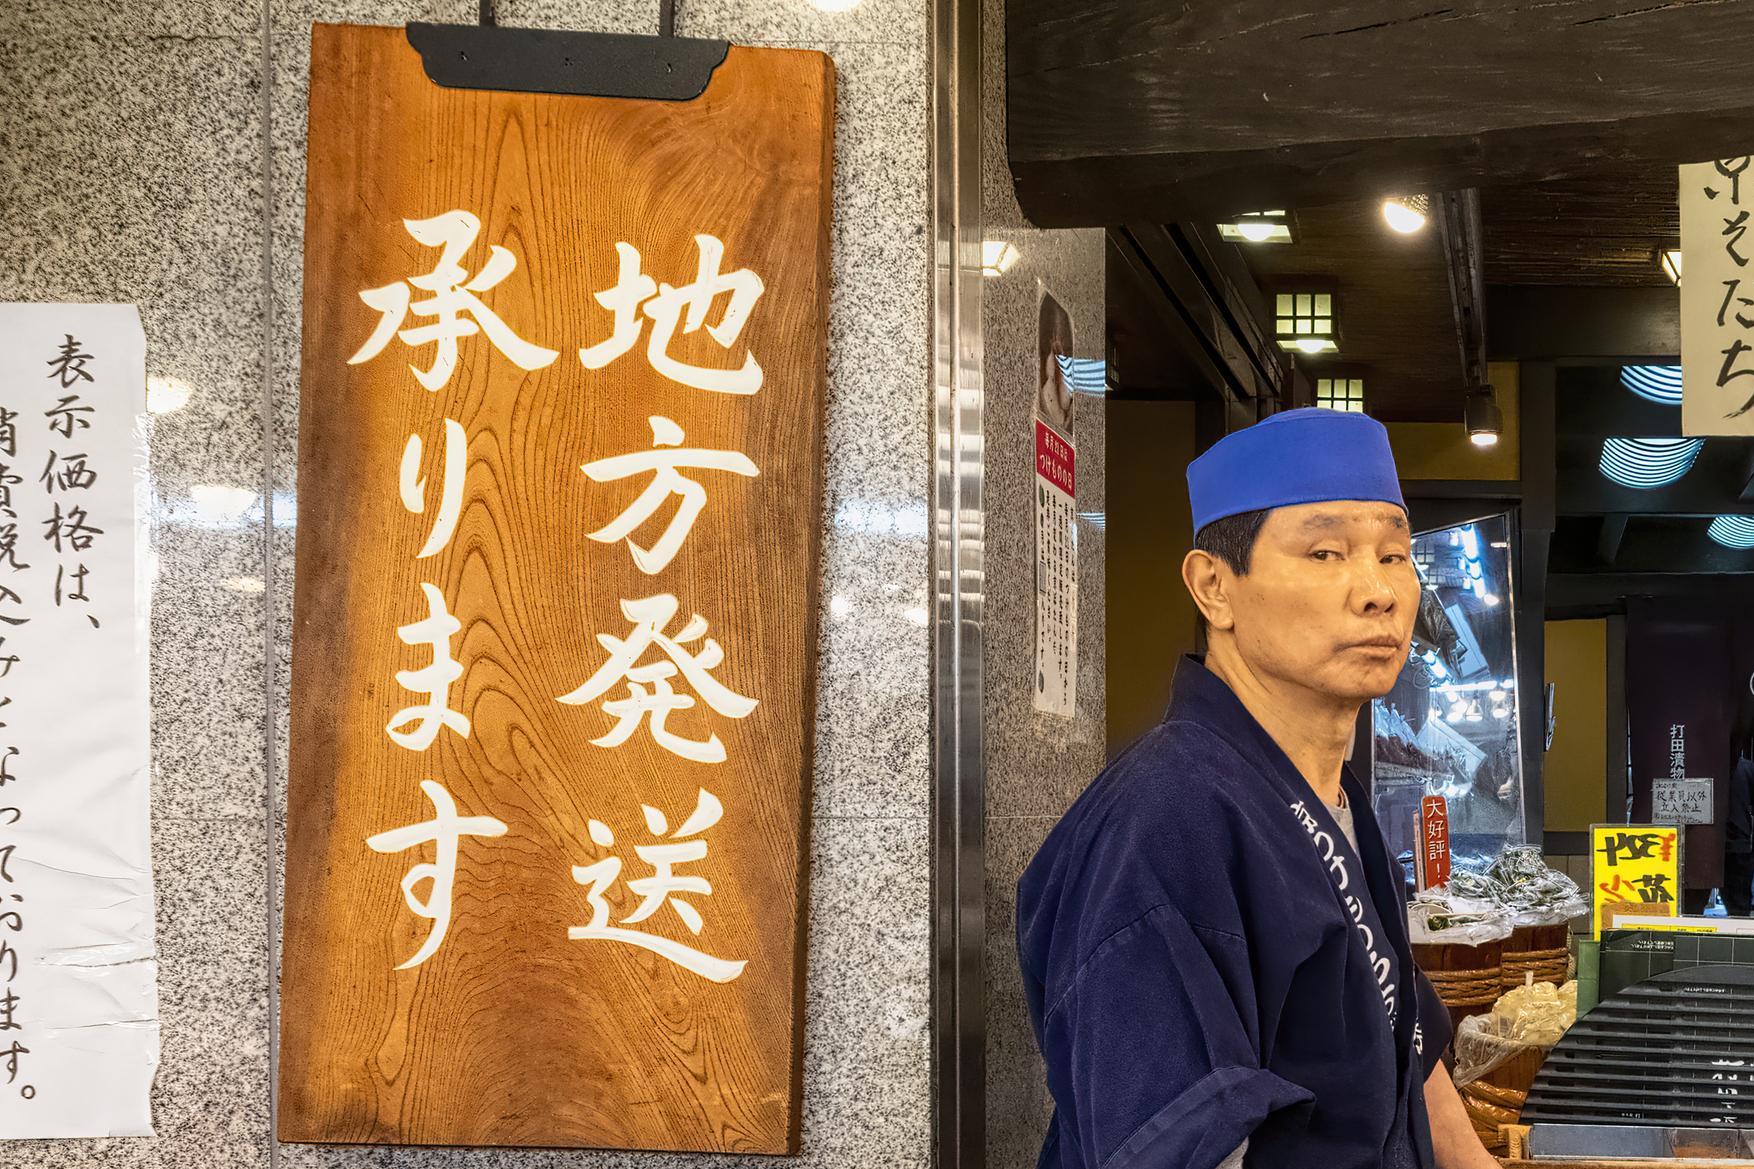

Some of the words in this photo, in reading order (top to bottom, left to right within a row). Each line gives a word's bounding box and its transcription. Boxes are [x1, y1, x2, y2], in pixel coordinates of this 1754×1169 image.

[39, 333, 105, 629] 表示価格は、
[347, 209, 560, 971] 承ります
[556, 234, 765, 984] 地方発送
[1426, 799, 1447, 879] 大好評！
